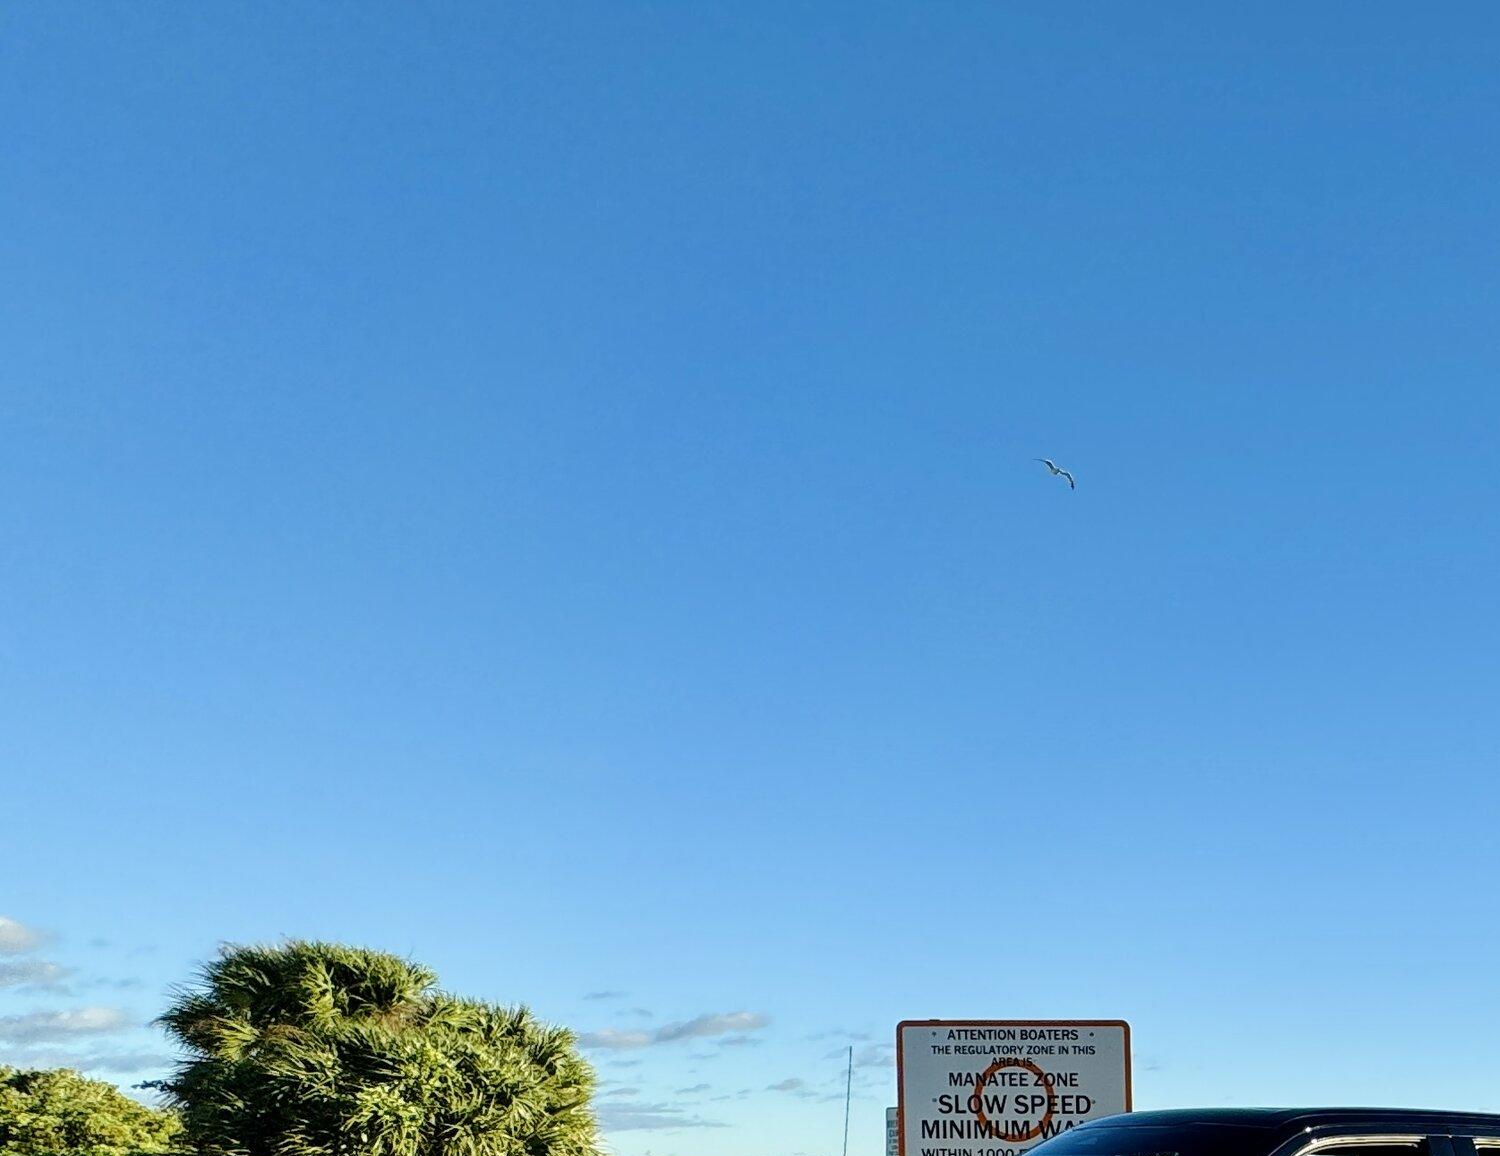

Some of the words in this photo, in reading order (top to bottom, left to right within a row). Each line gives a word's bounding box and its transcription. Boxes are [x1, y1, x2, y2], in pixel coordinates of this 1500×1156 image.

[946, 1029, 1016, 1041] ATTENTION
[1020, 1029, 1079, 1041] BOATERS
[931, 1045, 951, 1055] THE
[954, 1045, 1024, 1055] REGULATORY
[1026, 1045, 1054, 1055] ZONE
[1058, 1045, 1069, 1055] IN
[1072, 1045, 1096, 1055] THIS
[991, 1057, 1020, 1067] AREA
[949, 1072, 1028, 1087] MANATEE
[1033, 1072, 1079, 1087] ZONE
[938, 1094, 1008, 1115] SLOW
[1014, 1094, 1091, 1115] SPEED
[921, 1119, 1031, 1140] MINIMUM
